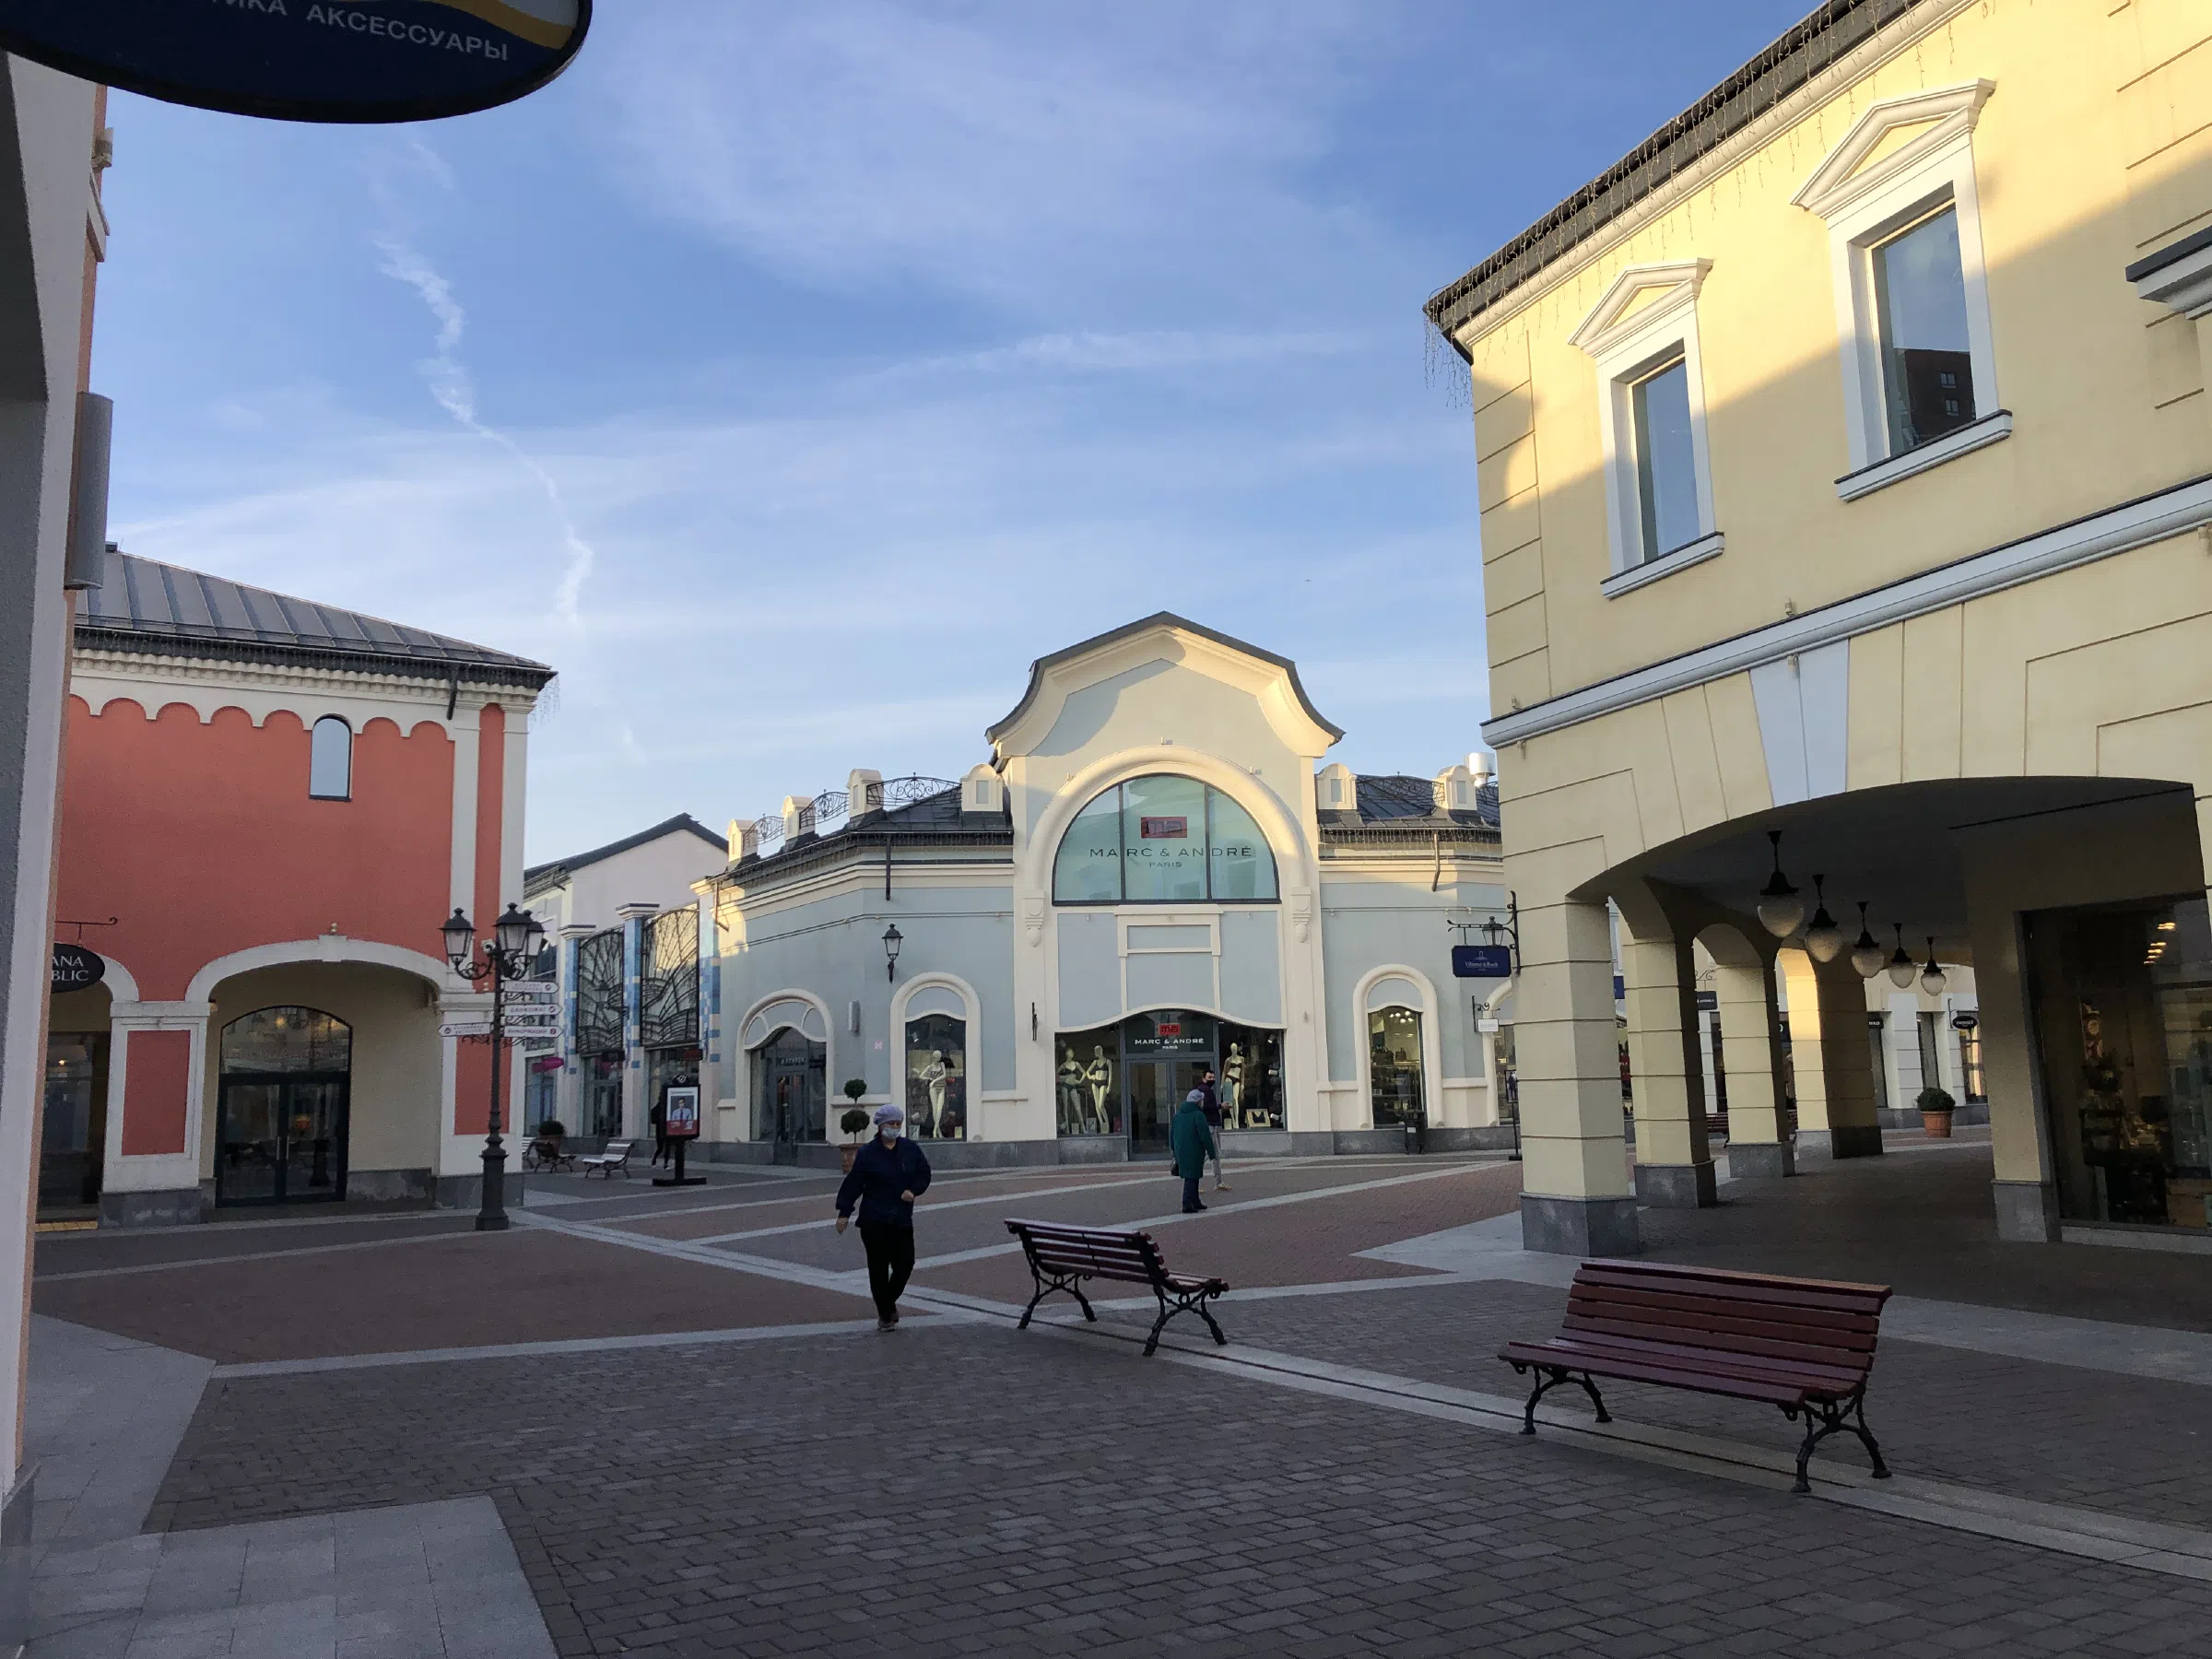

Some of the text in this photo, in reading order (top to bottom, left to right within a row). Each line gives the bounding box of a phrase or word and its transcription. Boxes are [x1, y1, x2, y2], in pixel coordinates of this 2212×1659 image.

[306, 4, 510, 62] АКСЕССУАРЫ
[1089, 845, 1253, 858] MARC & ANDRÉ
